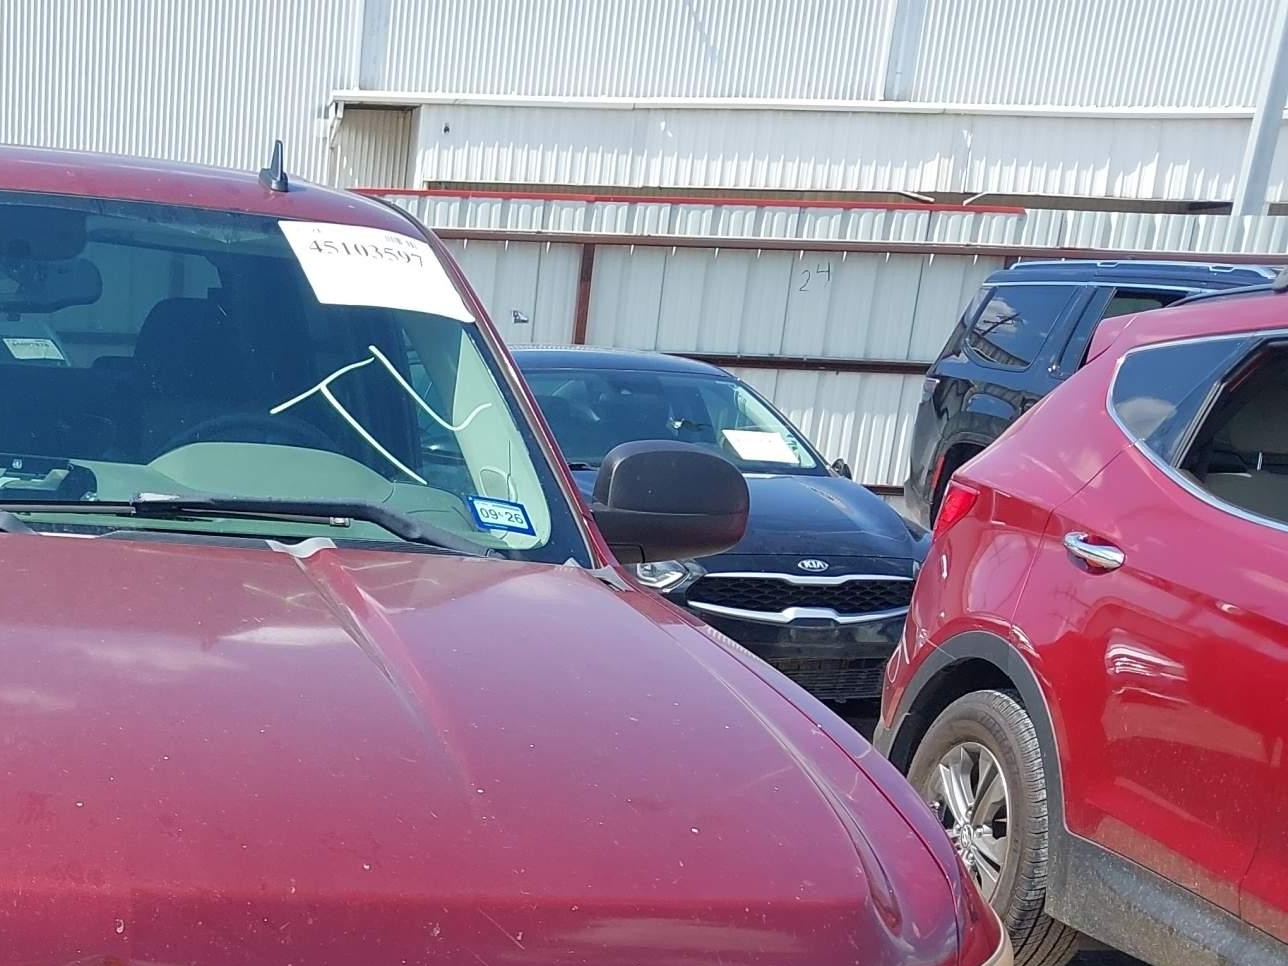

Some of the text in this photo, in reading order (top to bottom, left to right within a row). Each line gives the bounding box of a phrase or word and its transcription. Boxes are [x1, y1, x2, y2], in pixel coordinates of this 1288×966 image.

[309, 239, 424, 268] 45103597
[798, 261, 831, 292] 24
[479, 507, 524, 525] 09 26
[802, 559, 825, 570] KIA
